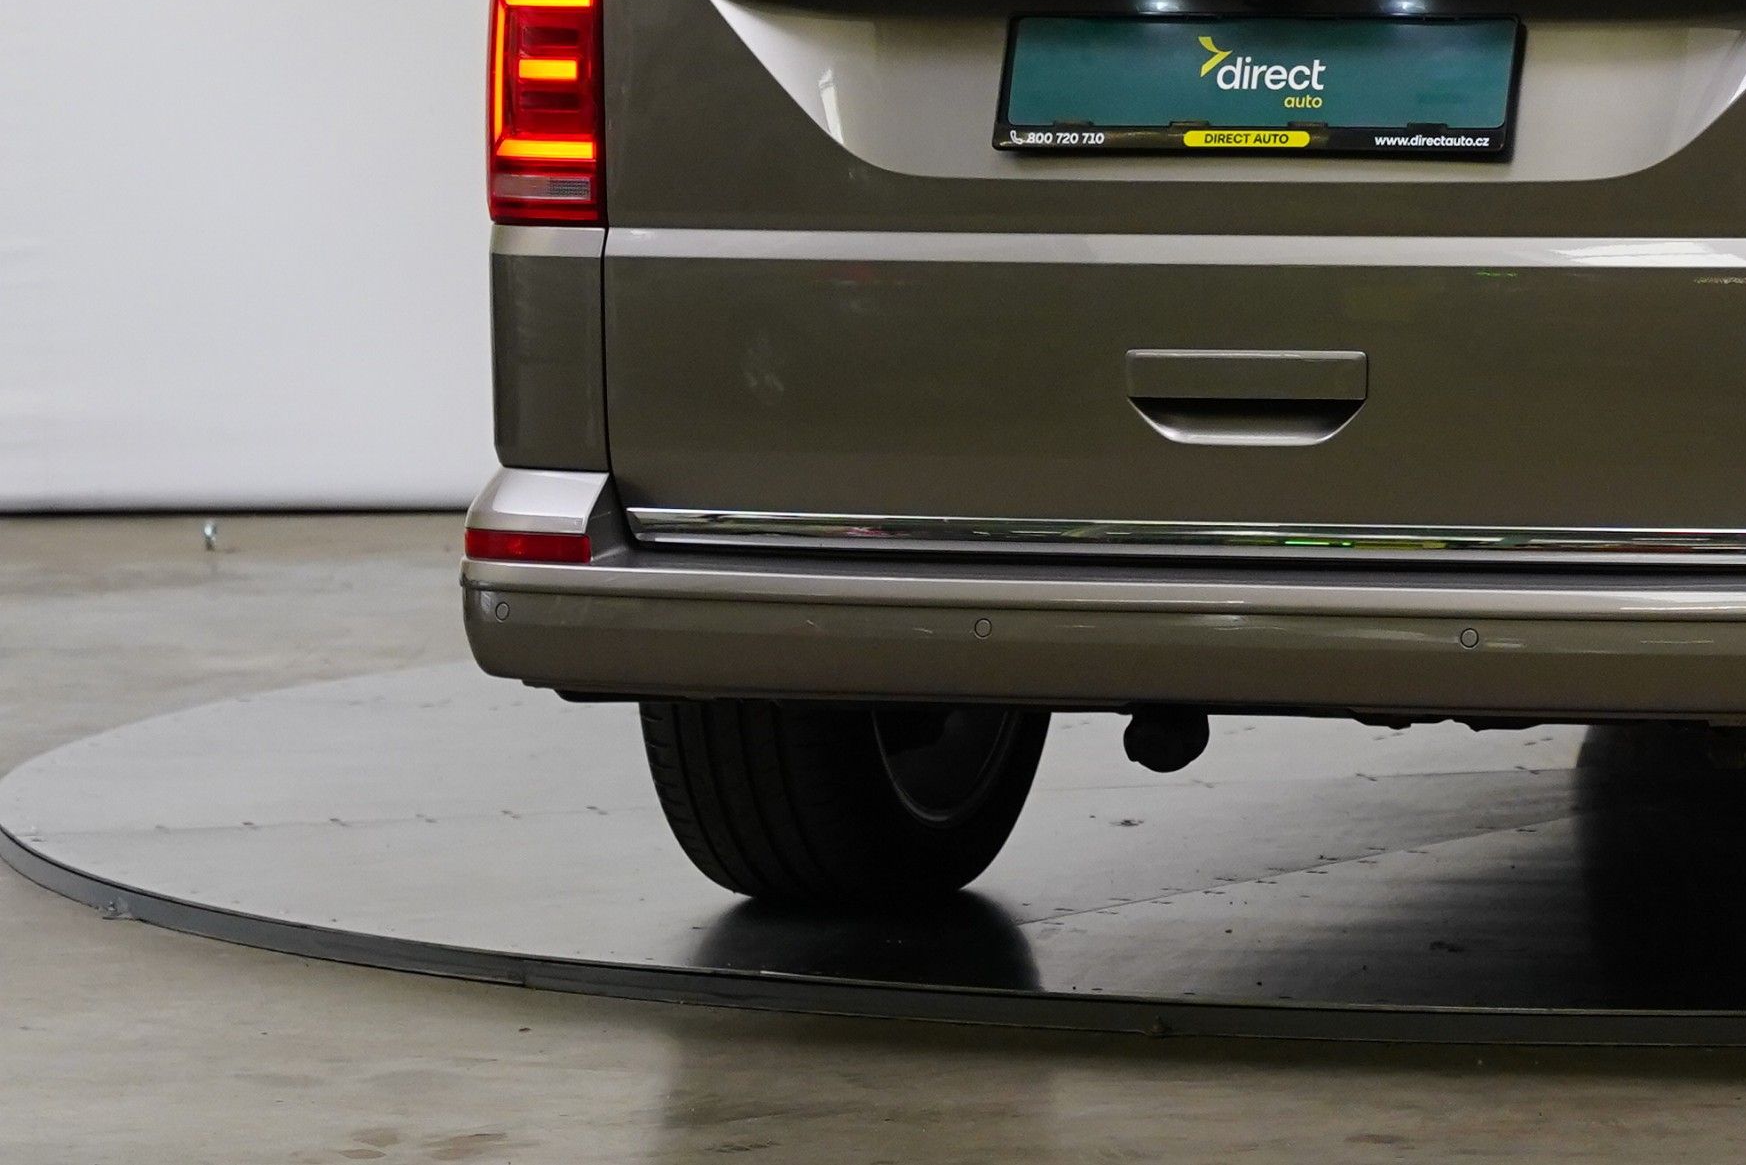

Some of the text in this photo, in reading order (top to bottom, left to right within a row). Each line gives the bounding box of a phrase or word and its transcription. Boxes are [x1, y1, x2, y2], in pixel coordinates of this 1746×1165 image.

[1216, 56, 1326, 90] direct
[1284, 95, 1323, 108] auto
[1027, 132, 1105, 144] 800 720 710
[1204, 133, 1289, 144] DIRECT AUTO
[1374, 134, 1490, 147] www.directauto.cz
